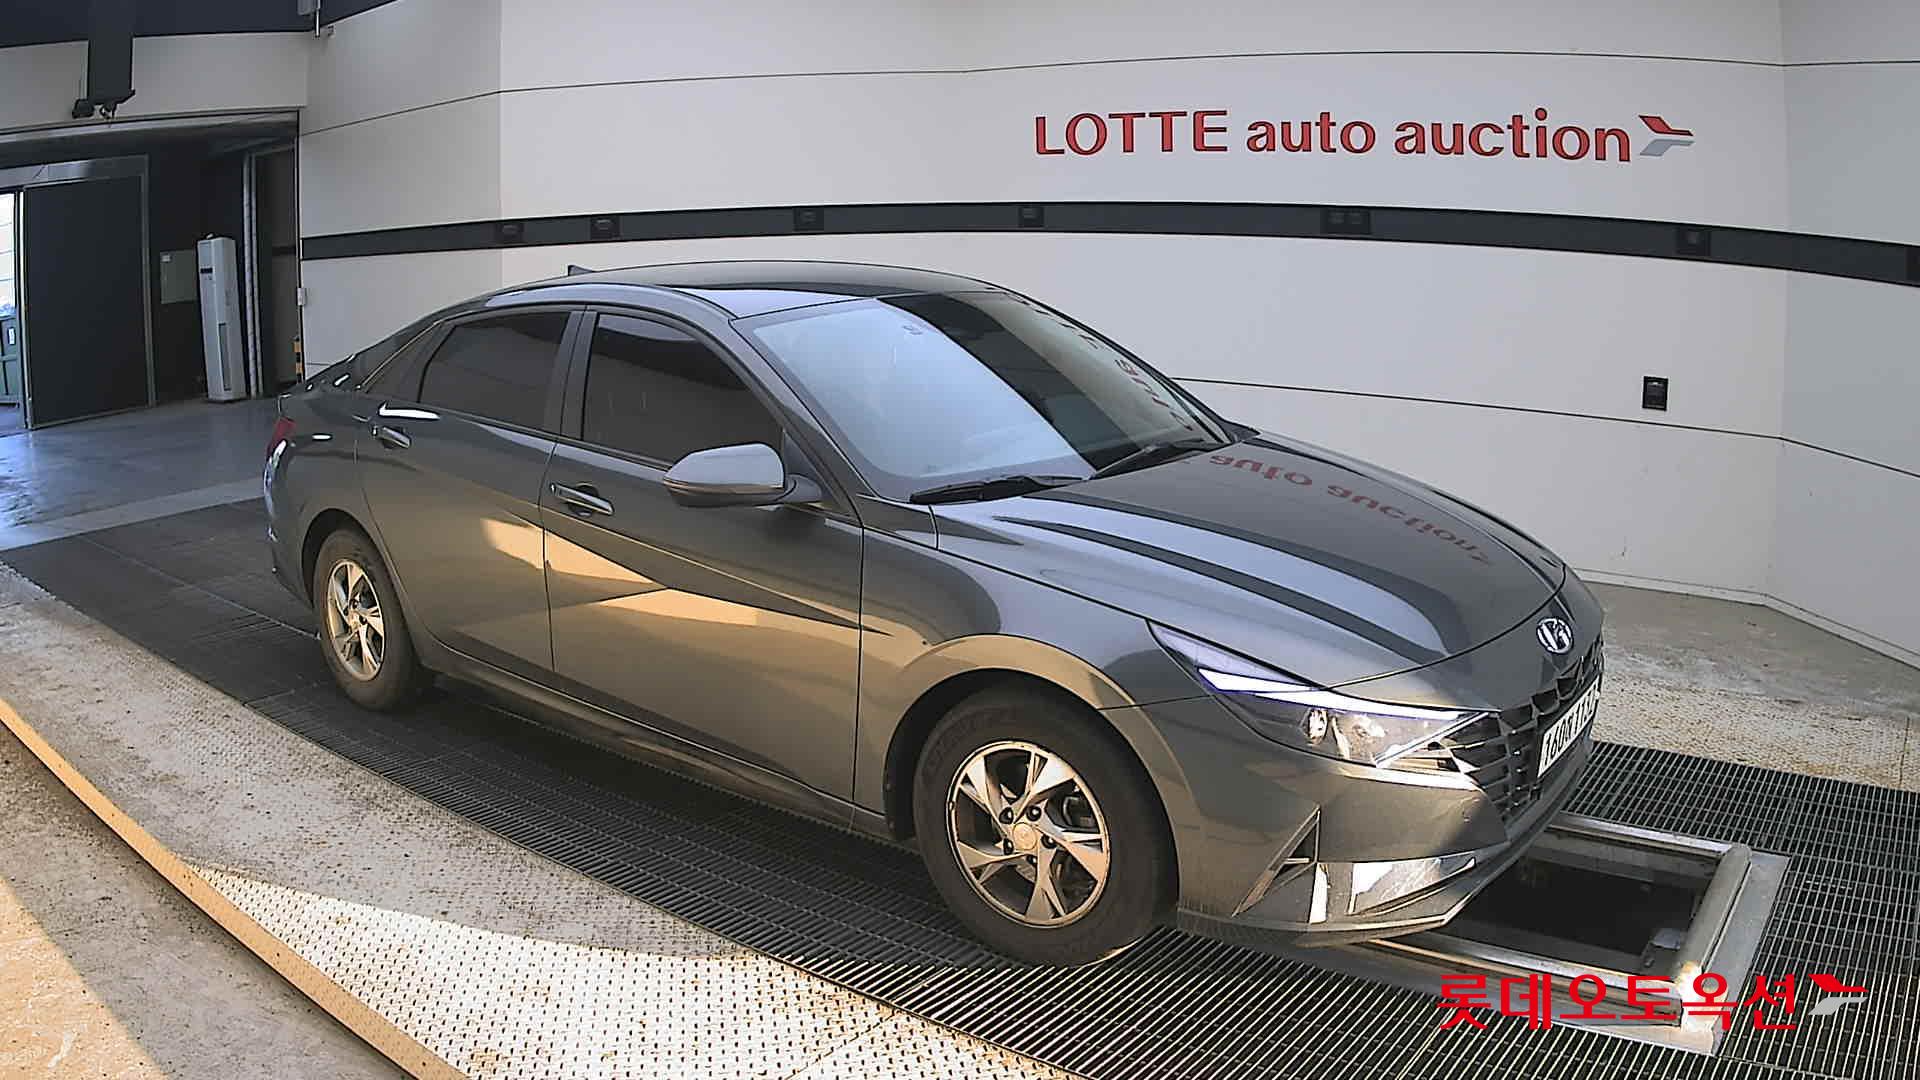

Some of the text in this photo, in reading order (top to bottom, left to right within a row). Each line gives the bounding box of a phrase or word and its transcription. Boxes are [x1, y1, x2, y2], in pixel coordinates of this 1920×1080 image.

[1035, 108, 1631, 162] LOTTE auto auction
